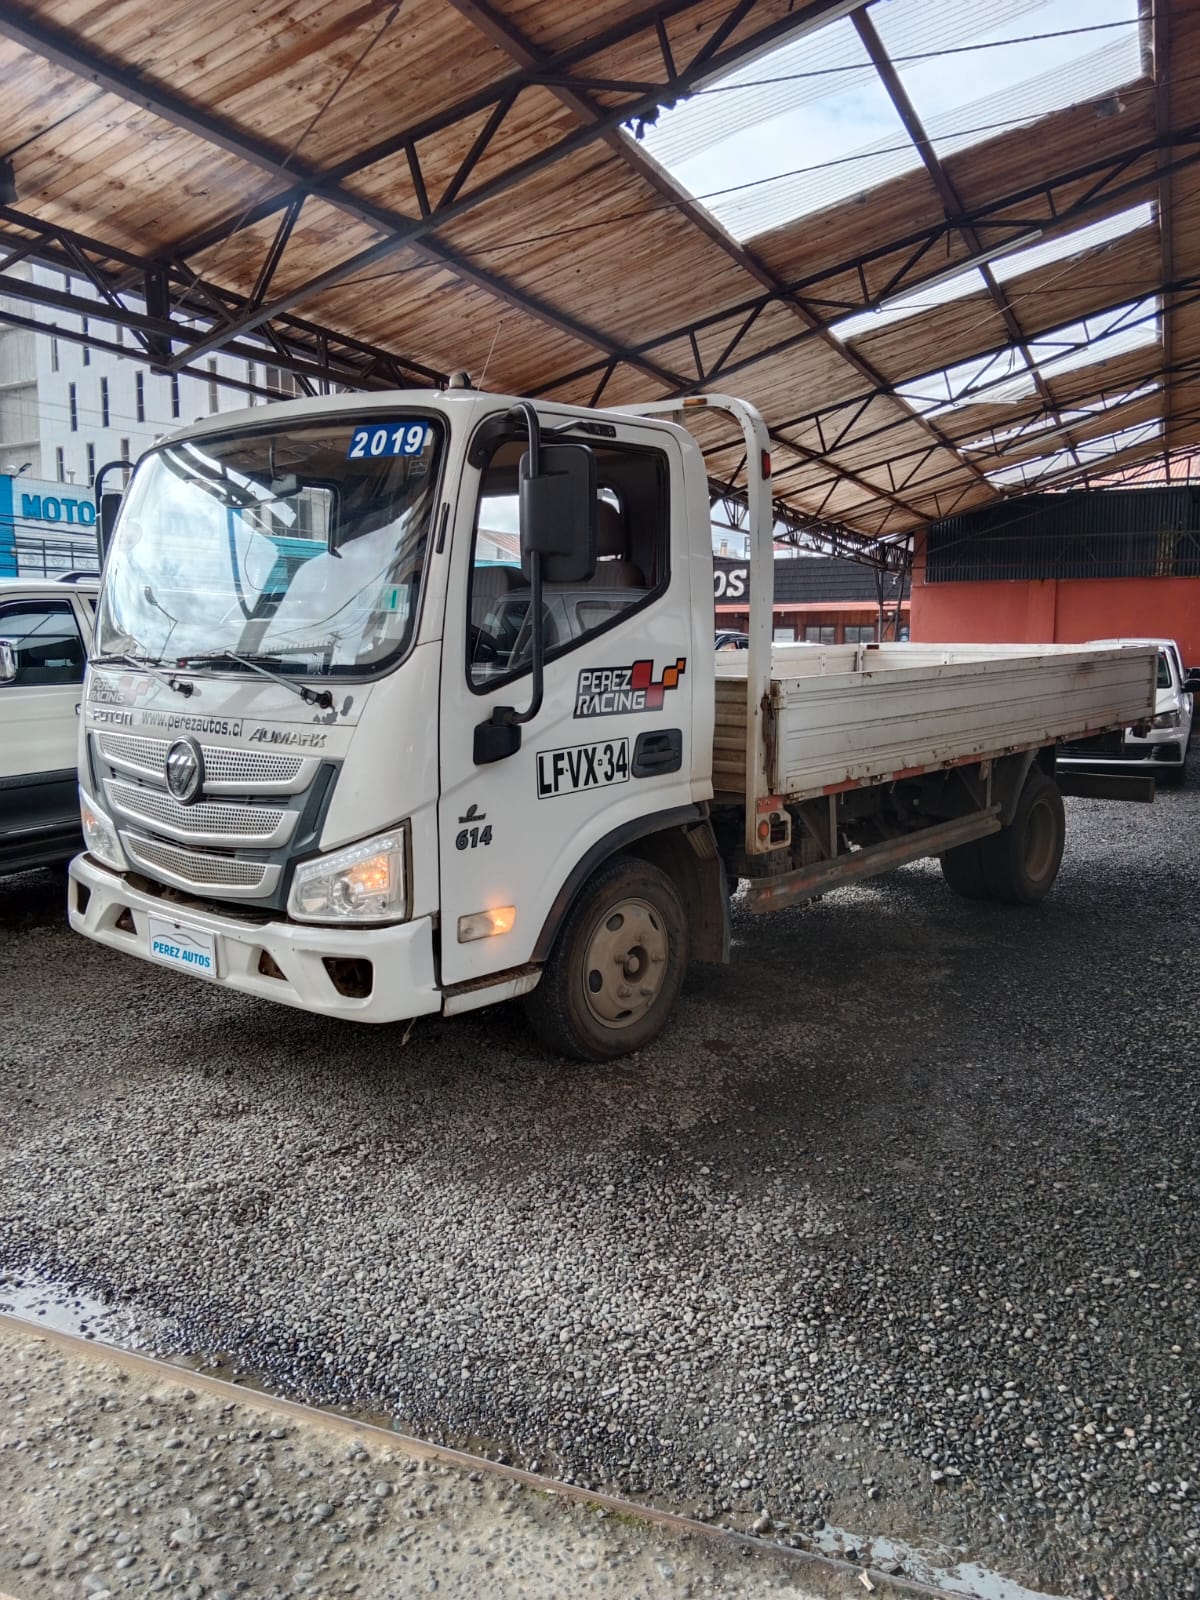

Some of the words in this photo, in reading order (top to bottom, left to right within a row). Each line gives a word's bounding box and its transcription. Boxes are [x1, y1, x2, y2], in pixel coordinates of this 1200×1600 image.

[350, 426, 423, 458] 2019
[21, 494, 96, 526] MOTO
[579, 669, 632, 694] PEREZ
[576, 691, 646, 715] RACING
[142, 711, 244, 737] www.perezautos.cl
[248, 726, 328, 748] AUMARK
[456, 825, 492, 851] 614
[153, 941, 181, 959] PEREZ
[182, 950, 210, 968] AUTOS
